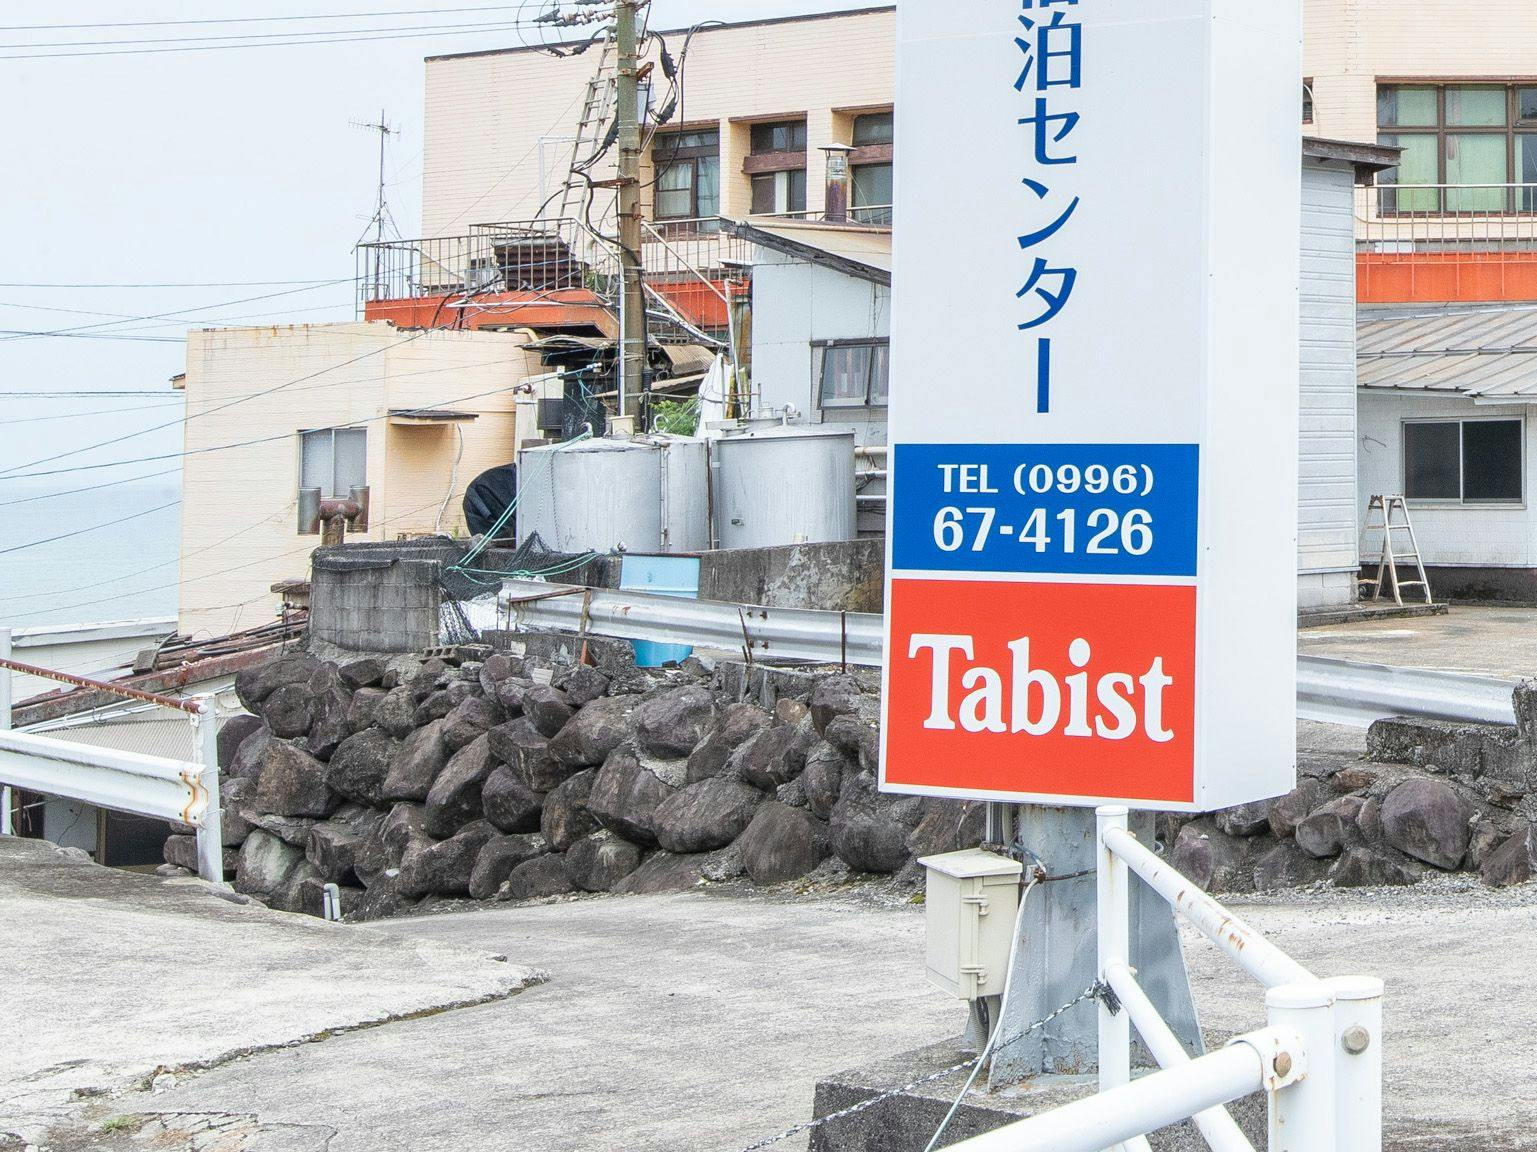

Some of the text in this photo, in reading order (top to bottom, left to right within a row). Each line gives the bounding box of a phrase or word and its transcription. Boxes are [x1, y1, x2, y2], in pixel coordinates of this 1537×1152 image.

[937, 463, 1154, 496] TEL (0996)
[933, 506, 1153, 555] 67-4126
[908, 633, 1174, 742] Tabist
